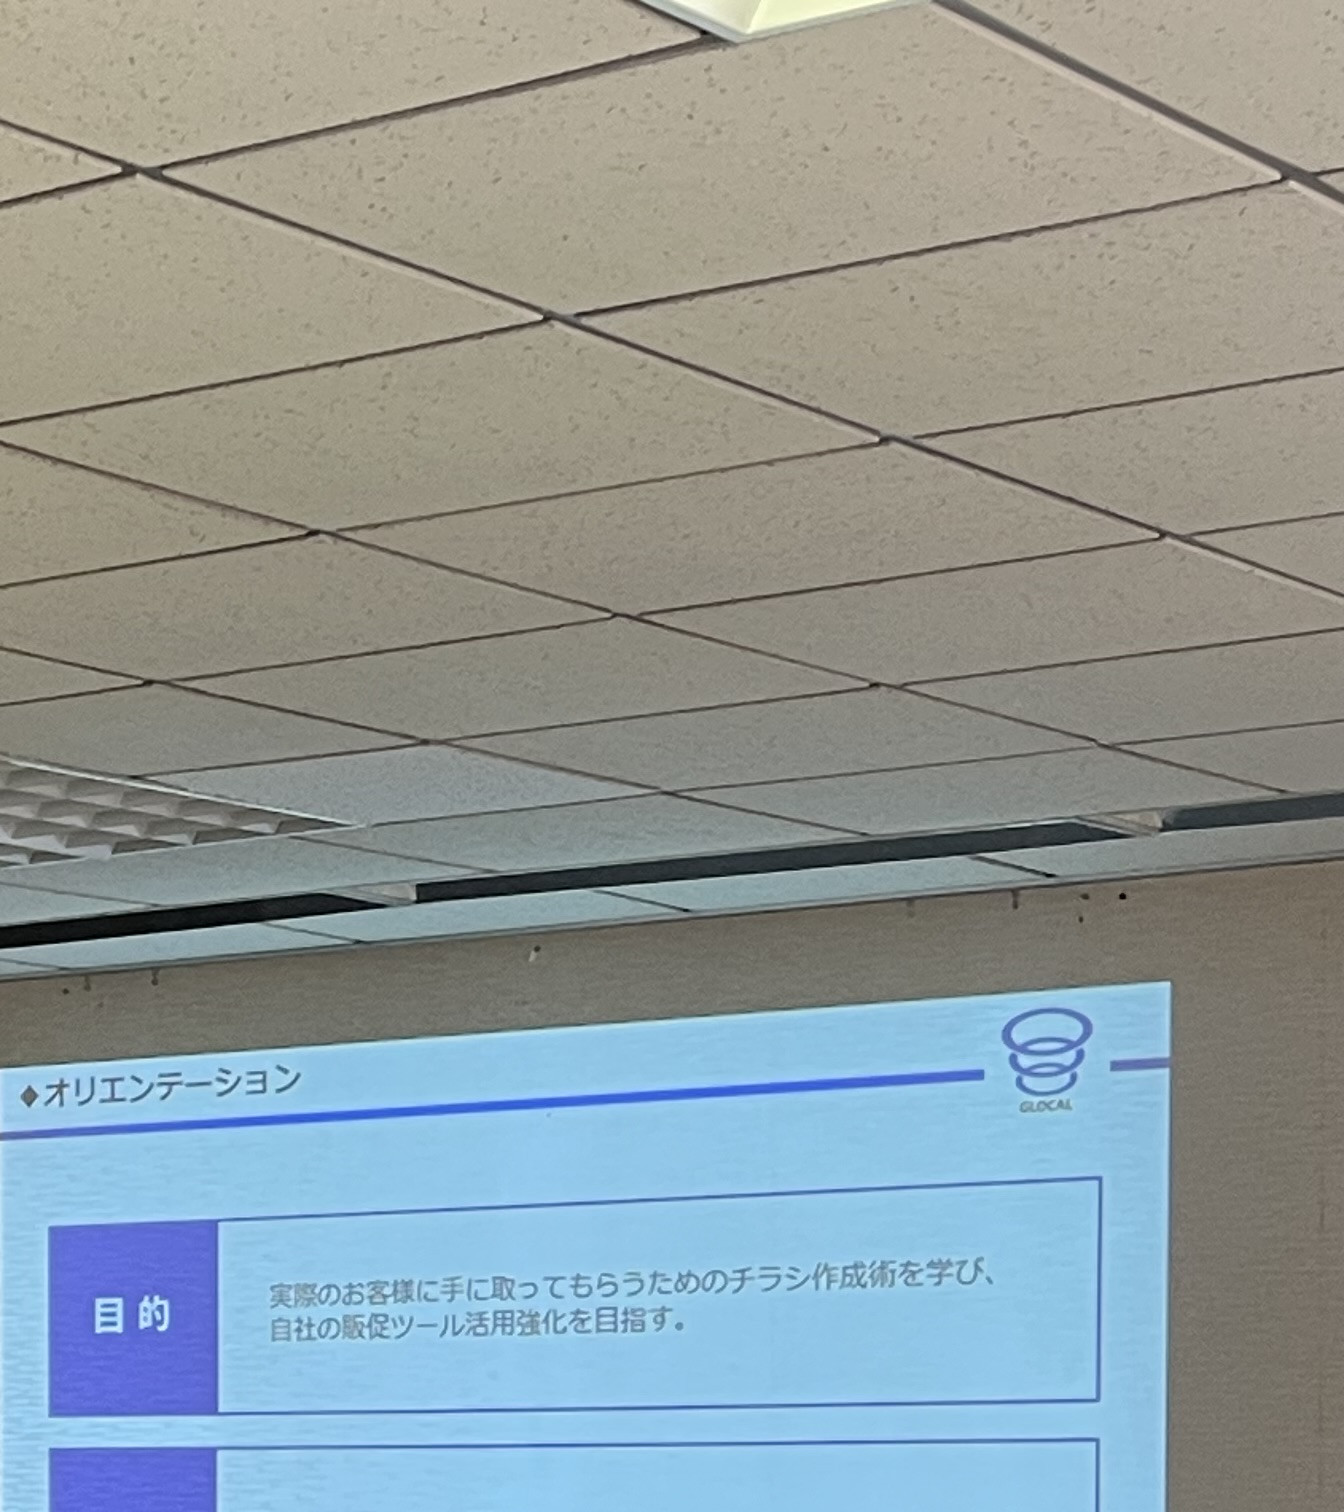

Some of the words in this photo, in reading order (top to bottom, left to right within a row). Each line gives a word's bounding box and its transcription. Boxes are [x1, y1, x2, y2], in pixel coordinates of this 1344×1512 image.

[1019, 1099, 1073, 1113] GLOCAL
[269, 1256, 994, 1309] 実際のお客様に手に取ってもらうためのチラシ作成術を学び、
[270, 1305, 685, 1342] 自社の販促ツール活用強化を目指す。
